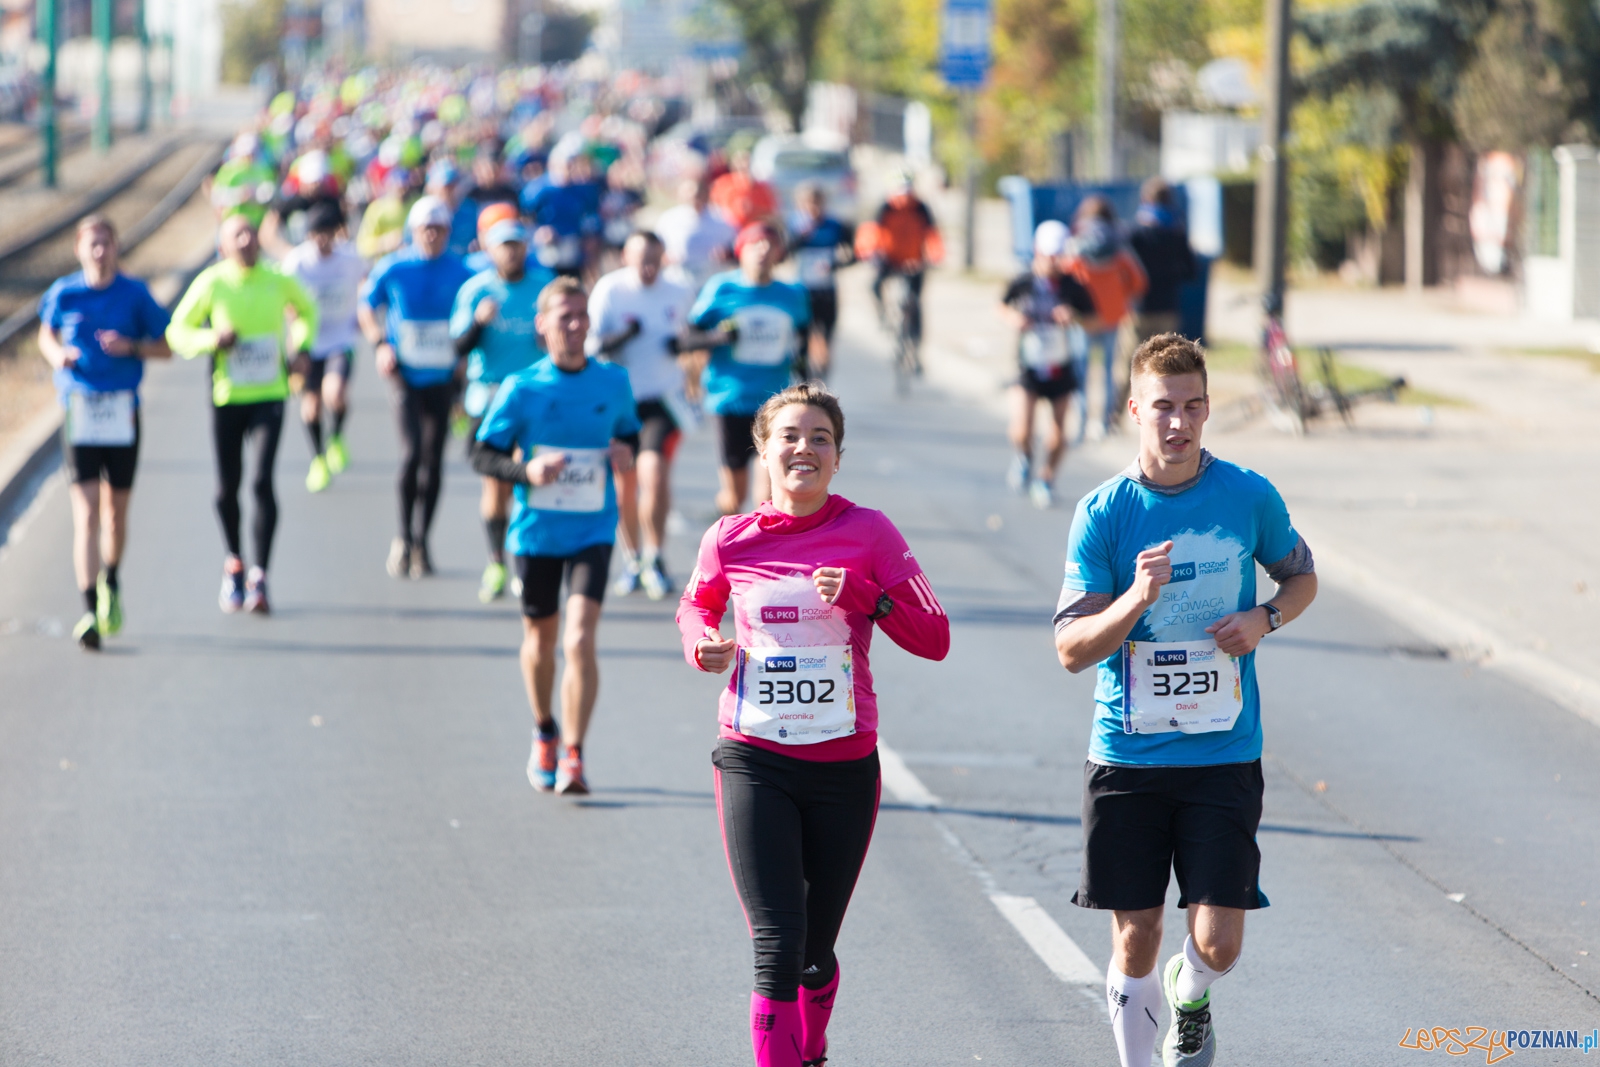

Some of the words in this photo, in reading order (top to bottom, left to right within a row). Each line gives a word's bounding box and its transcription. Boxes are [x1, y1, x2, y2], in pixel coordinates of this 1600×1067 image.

[1174, 567, 1193, 577] PKO
[1199, 566, 1229, 575] maraton
[1162, 590, 1189, 602] SIŁA
[1171, 596, 1224, 613] ODWAGA
[763, 611, 776, 620] 16.
[776, 610, 796, 620] PKO
[802, 613, 832, 621] maraton
[1163, 607, 1225, 626] SZYBKOŚĆ
[1156, 654, 1167, 662] 16.
[766, 660, 776, 668] 16.
[777, 660, 794, 668] PKO
[1153, 670, 1219, 697] 3231
[759, 679, 835, 704] 3302
[1176, 703, 1198, 711] David
